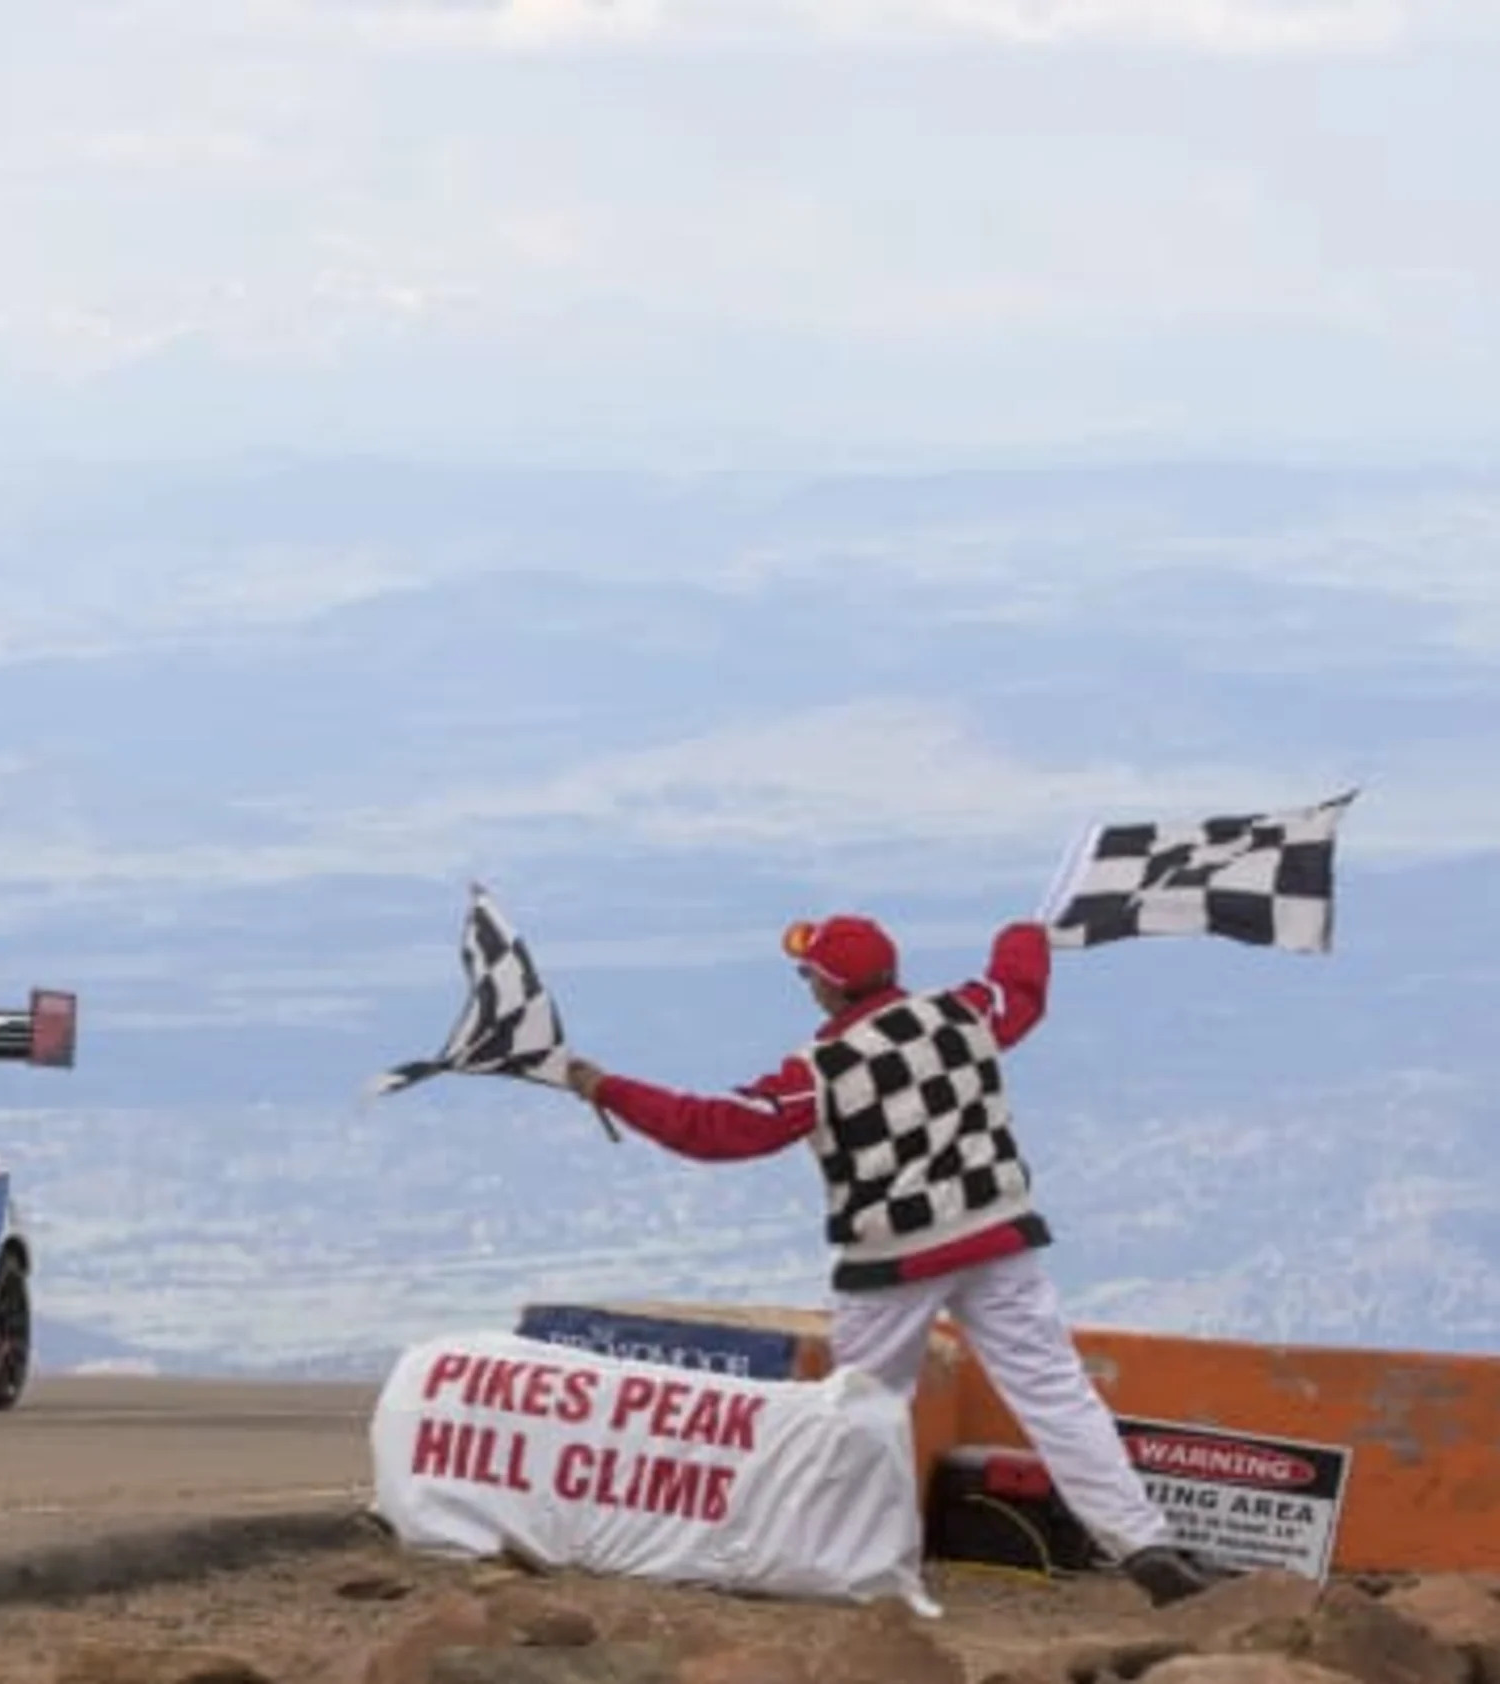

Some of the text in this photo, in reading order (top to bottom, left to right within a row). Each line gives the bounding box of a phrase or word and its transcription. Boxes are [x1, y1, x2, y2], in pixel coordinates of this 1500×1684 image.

[423, 1352, 767, 1452] PIKES PEAK
[411, 1419, 738, 1525] HILL CLIMB
[1137, 1437, 1292, 1481] WARNING
[1230, 1493, 1315, 1525] AREA
